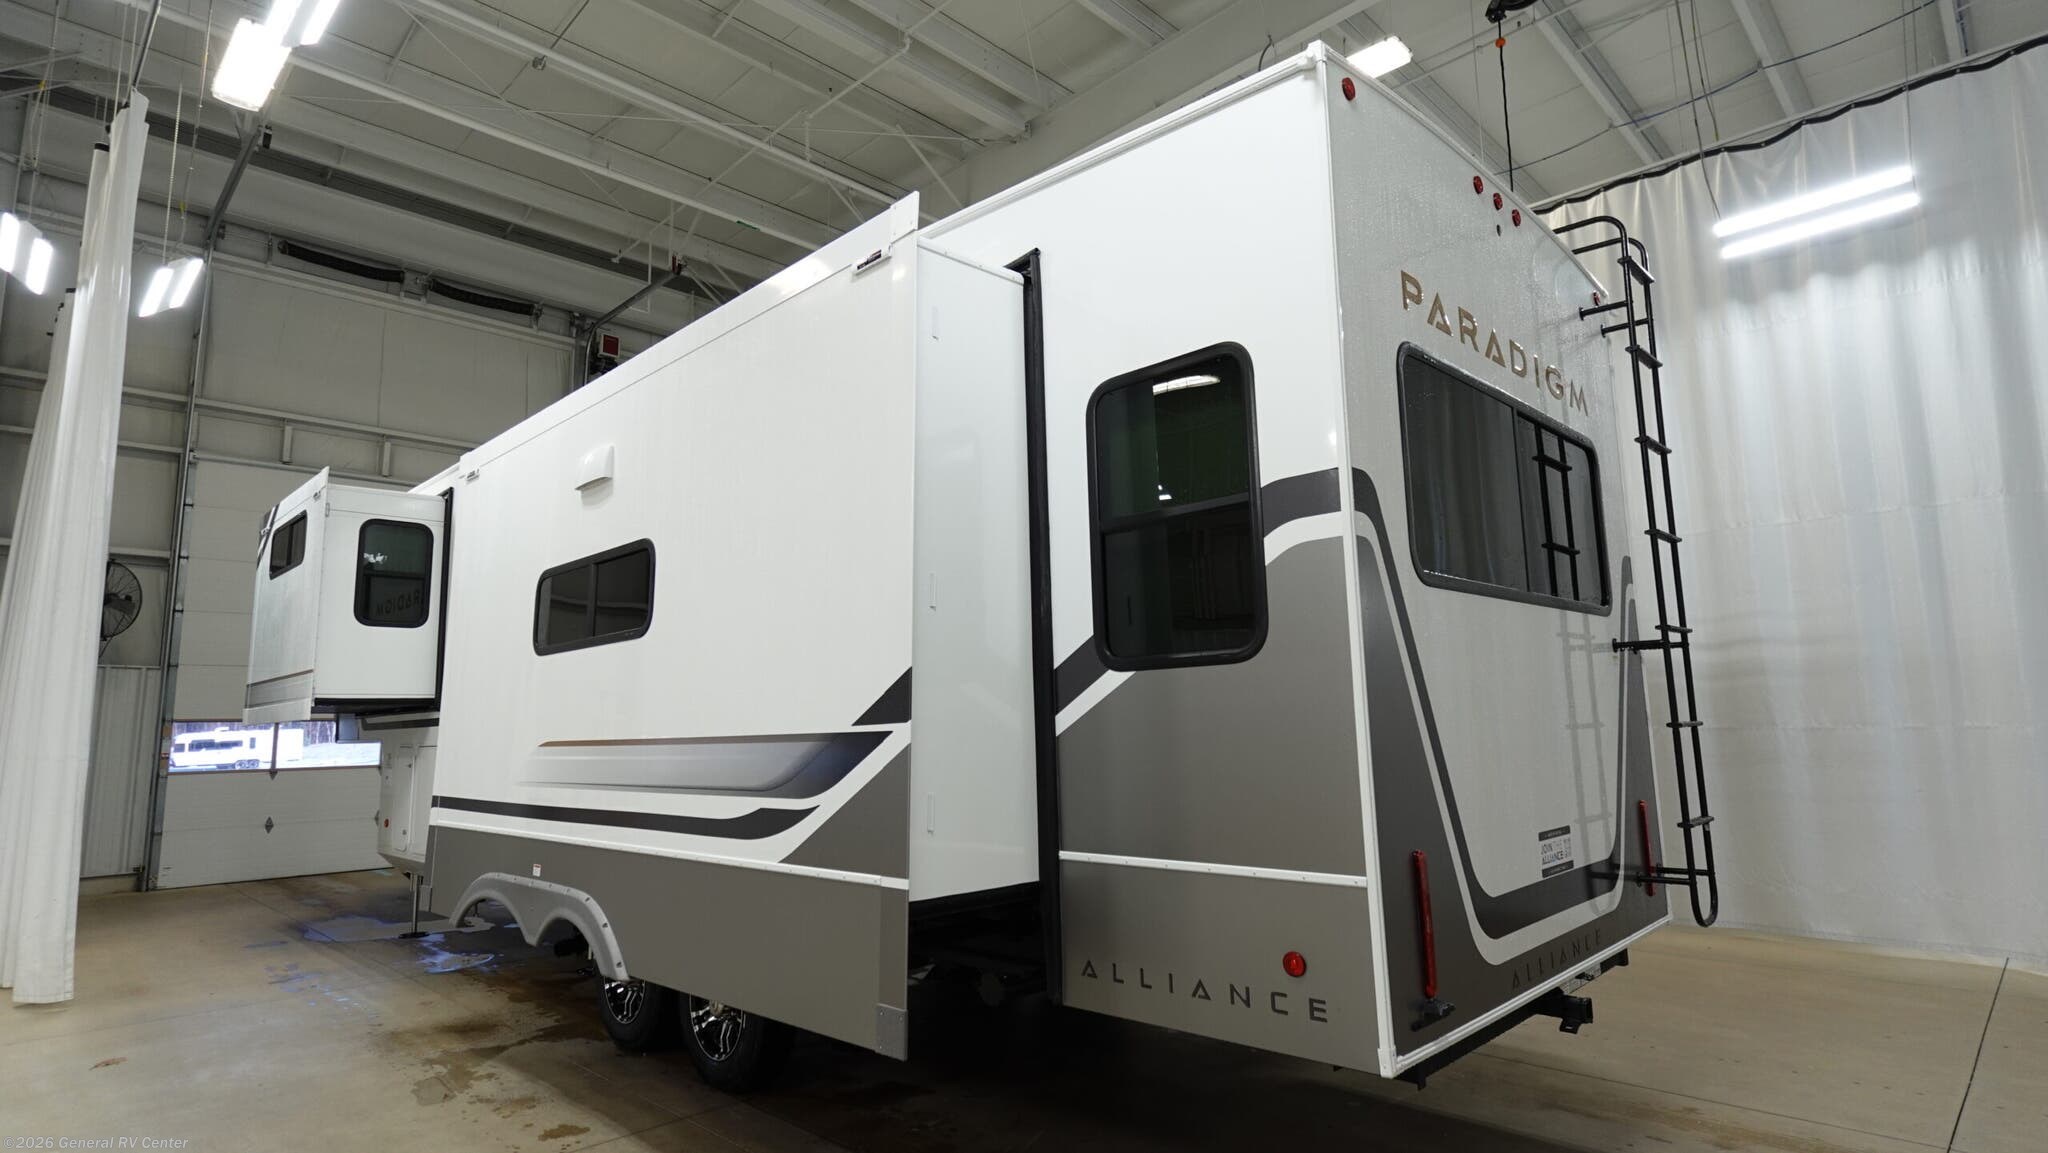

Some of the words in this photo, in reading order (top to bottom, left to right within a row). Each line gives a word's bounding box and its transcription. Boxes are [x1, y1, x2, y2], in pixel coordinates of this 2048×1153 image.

[1400, 270, 1589, 417] PARADIGM
[1512, 928, 1601, 990] ALLIANCE
[1081, 960, 1328, 1023] ALLIANCE
